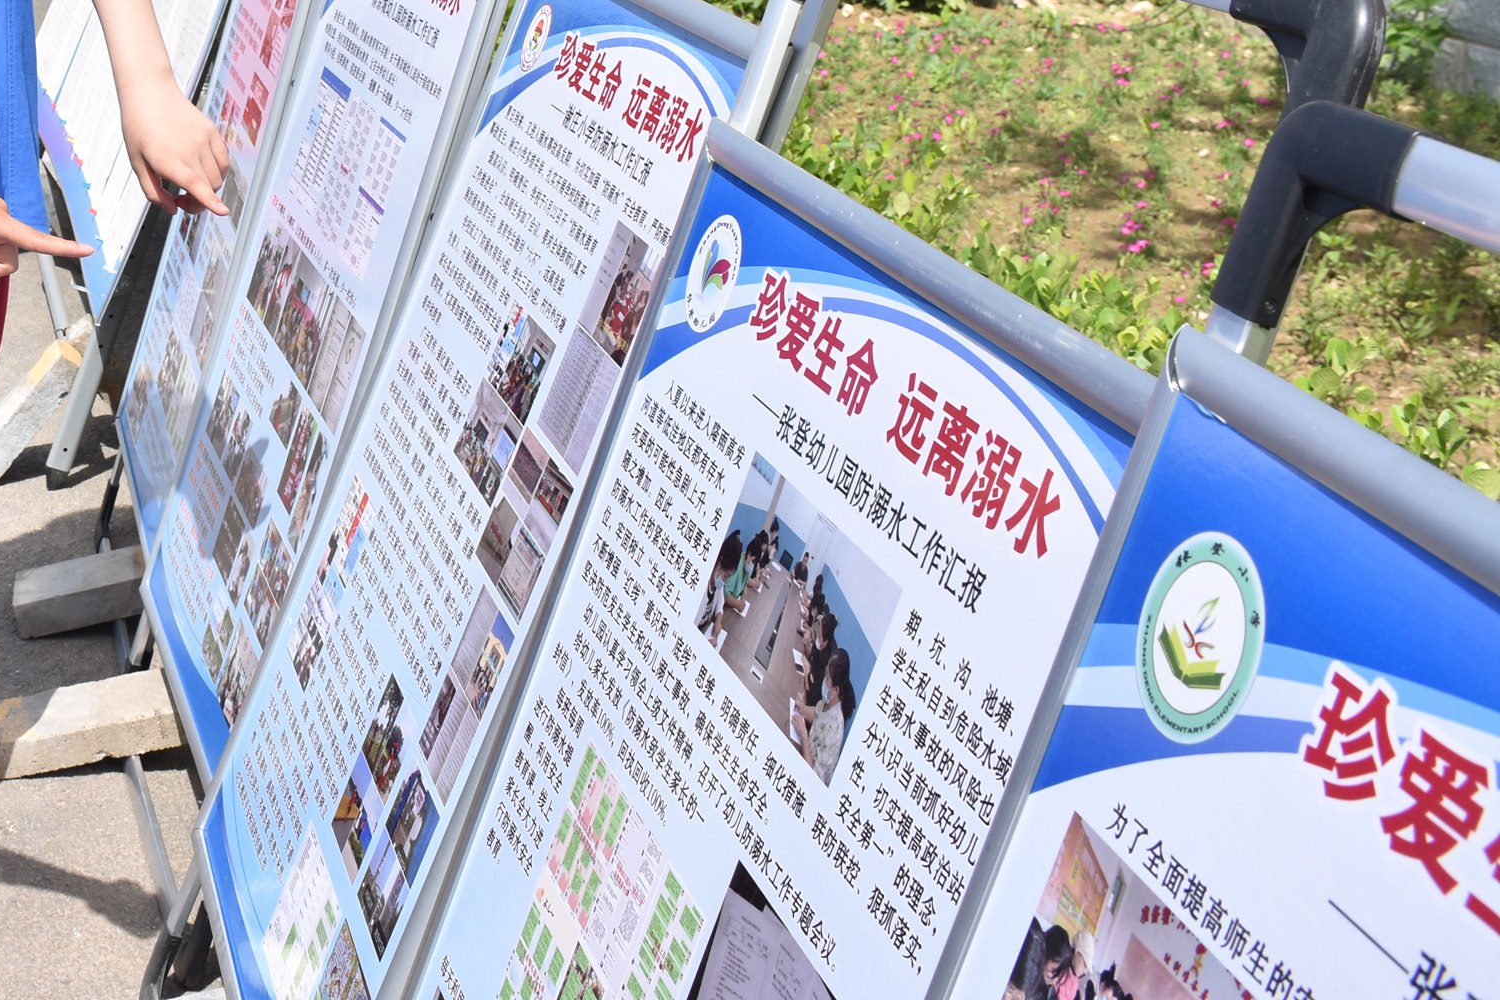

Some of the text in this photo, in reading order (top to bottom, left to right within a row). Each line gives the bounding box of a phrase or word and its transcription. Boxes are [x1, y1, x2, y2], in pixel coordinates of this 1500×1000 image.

[550, 104, 653, 186] ——谢庄小学防溺水工作汇报
[551, 36, 622, 111] 珍爱生命
[621, 73, 703, 162] 远离溺水
[746, 277, 878, 416] 珍爱生命
[886, 372, 1079, 558] 远离溺水
[752, 393, 986, 613] ——张登幼儿园防溺水工作汇报
[631, 422, 994, 825] 玩耍的可能性急剧上升，发 生溺水事故的风险也
[640, 393, 1012, 787] 河道等低洼地区都有存水， 学生私自到危险水域
[664, 380, 745, 469] 入夏以来进入降雨高发
[903, 608, 1014, 736] 期，坑、沟、池塘、
[533, 695, 574, 767] 进行防溺水提
[552, 641, 667, 826] 封信》，发放率100%，回执回收100%。
[555, 686, 584, 738] 每班每周
[572, 629, 704, 822] 给幼儿家长发放《防溺水致学生家长的一
[581, 559, 767, 824] 坚决防范发生学生和幼儿溺亡事故，确保学生生命安全。
[592, 532, 921, 974] 不断增强“红线”意识和“底线”思维，明确责任、细化措施、联防联控、狠抓落实，
[601, 505, 936, 935] 位，牢固树立“生命至上， 安全第一”的理念，
[610, 477, 964, 905] 防溺水工作的紧迫性和复杂 性，切实提高政治站
[620, 448, 978, 866] 随之增加。因此，我园要充 分认识当前抓好幼儿
[1141, 614, 1240, 735] ZHANG DENG ELEMENTARY SCHOOL
[486, 827, 501, 864] 教育。
[495, 801, 532, 876] 行防溺水安全
[504, 775, 543, 849] 家长会大力进
[514, 748, 552, 822] 教育课，线上
[523, 720, 562, 794] 醒，利用安全
[583, 602, 835, 971] 幼儿园认真学习领会上级文件精神，召开了幼儿防溺水工作专题会议。
